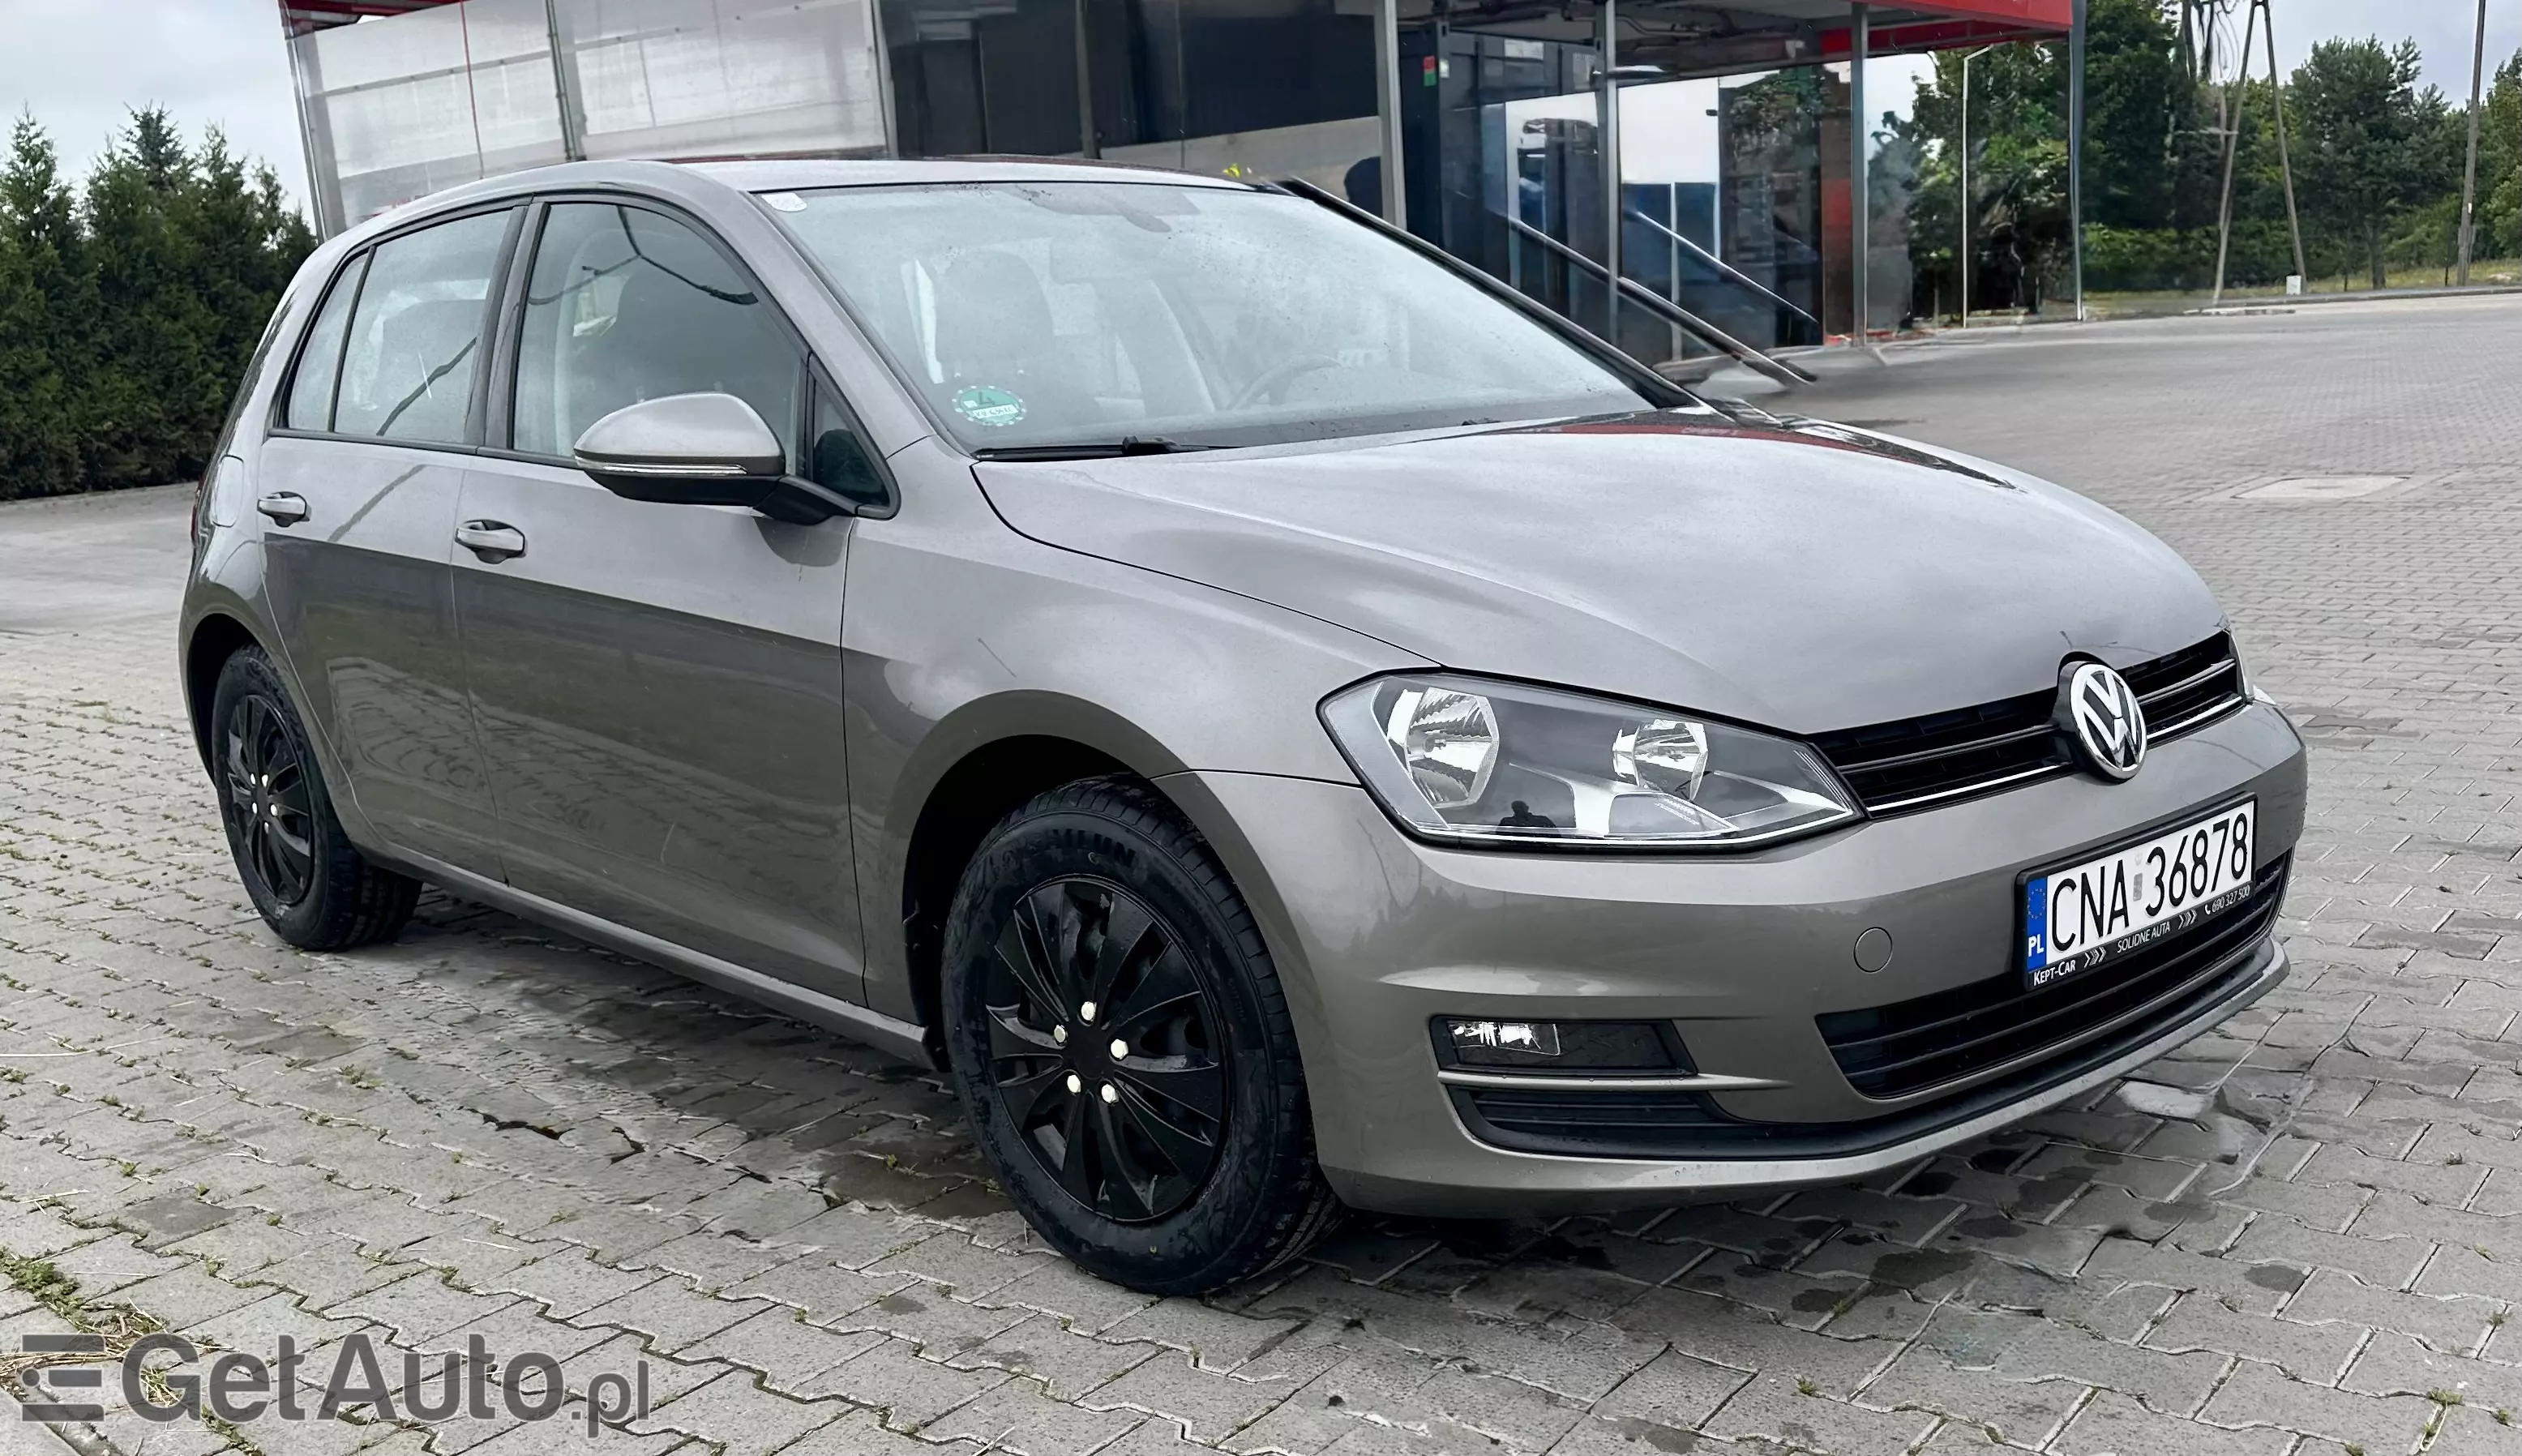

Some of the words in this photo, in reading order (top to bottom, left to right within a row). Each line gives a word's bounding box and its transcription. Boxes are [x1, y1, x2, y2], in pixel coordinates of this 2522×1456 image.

[2077, 666, 2145, 773] VW
[2052, 859, 2129, 952] CNA
[2145, 812, 2248, 917] 36878
[2027, 934, 2045, 957] PL
[2117, 928, 2151, 953] SOLIDNE
[2151, 921, 2171, 938] AUTA
